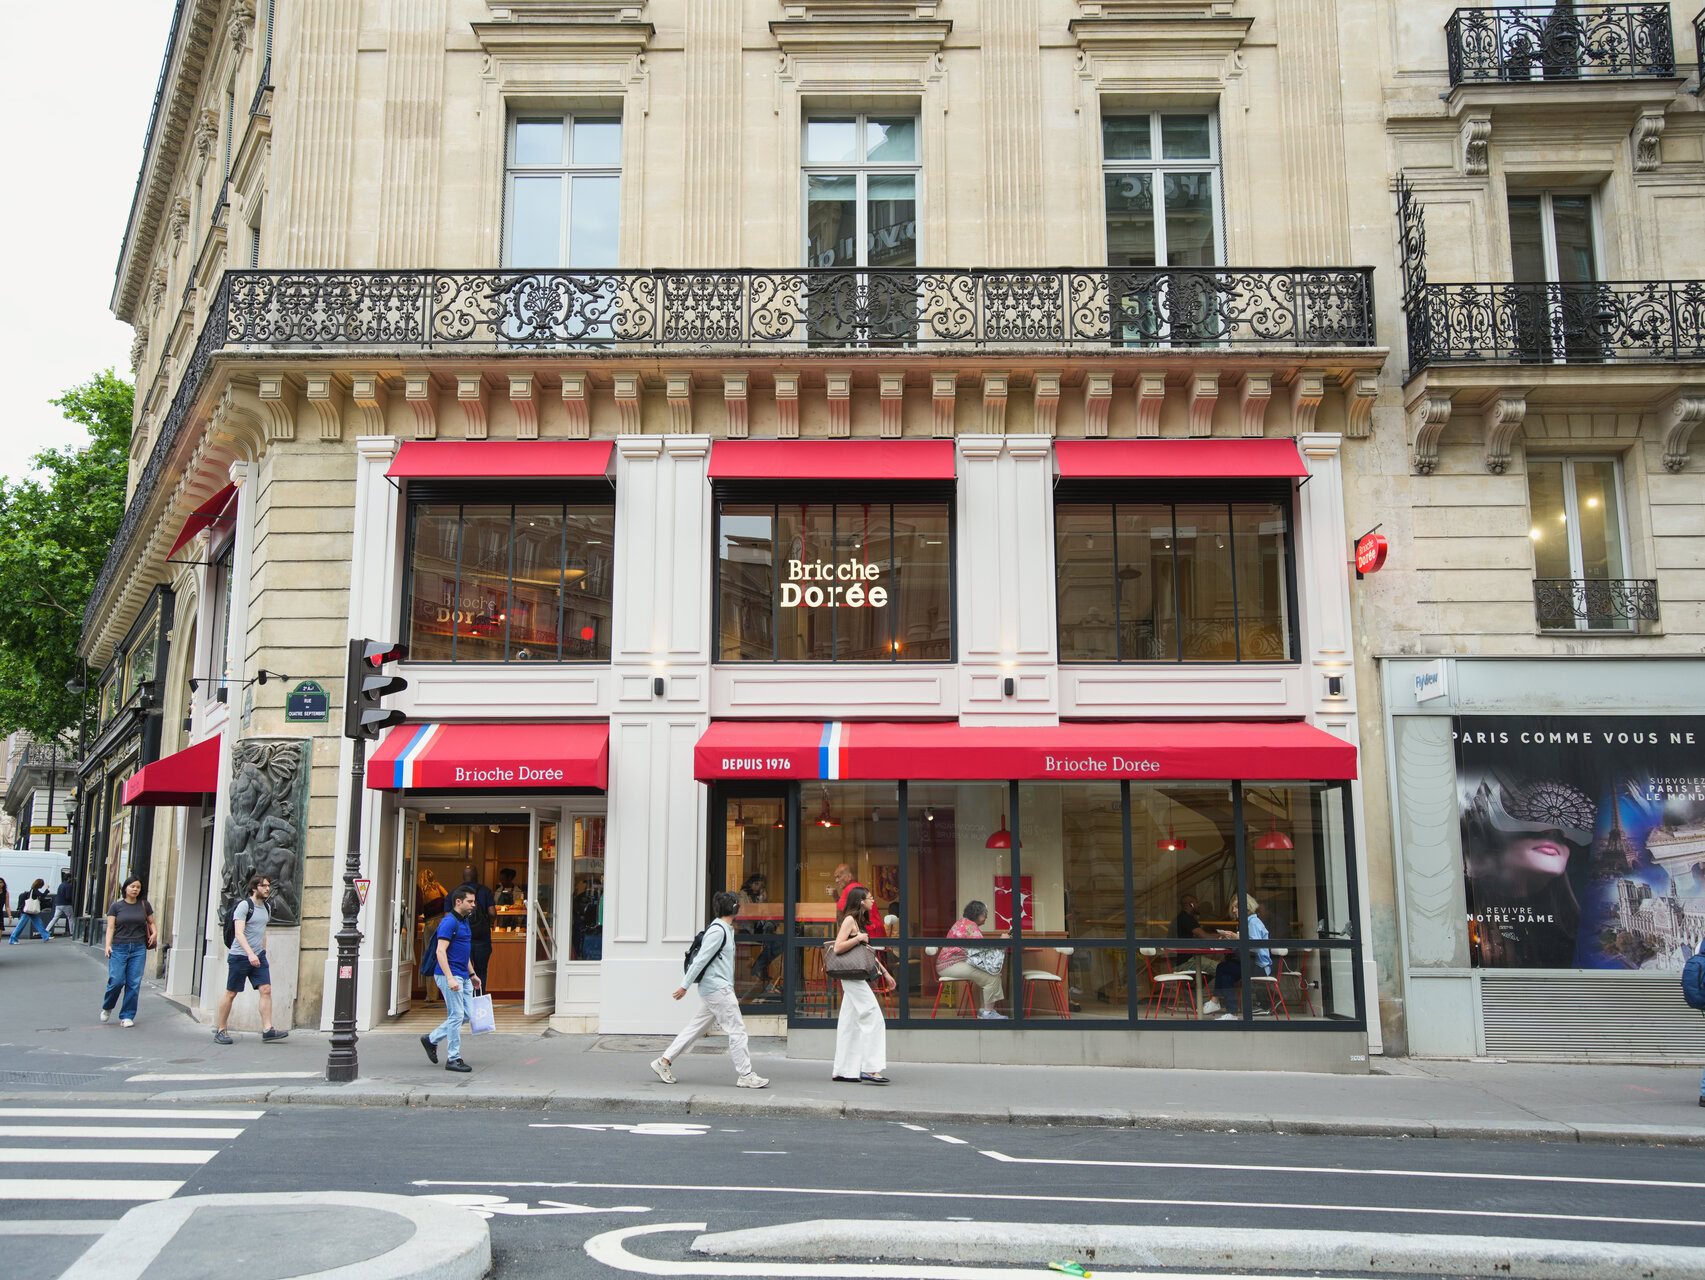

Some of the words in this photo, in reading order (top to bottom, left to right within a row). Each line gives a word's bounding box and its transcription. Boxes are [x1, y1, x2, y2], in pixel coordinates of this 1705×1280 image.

[788, 558, 880, 580] Brioche
[780, 583, 888, 607] Dorée
[1520, 732, 1592, 744] COMME
[1603, 732, 1658, 744] VOUS
[1670, 732, 1696, 744] NE
[722, 758, 763, 770] DEPUIS
[766, 758, 791, 770] 1976
[1045, 756, 1108, 771] Brioche
[1112, 756, 1160, 771] Dorée
[455, 767, 514, 781] Brioche
[518, 766, 563, 780] Dorée
[1650, 777, 1705, 785] SURVOLEZ
[1649, 784, 1688, 793] PARIS
[1646, 793, 1661, 801] LE
[1486, 906, 1533, 915] REVIVRE
[1466, 913, 1554, 923] NOTRE-DAME
